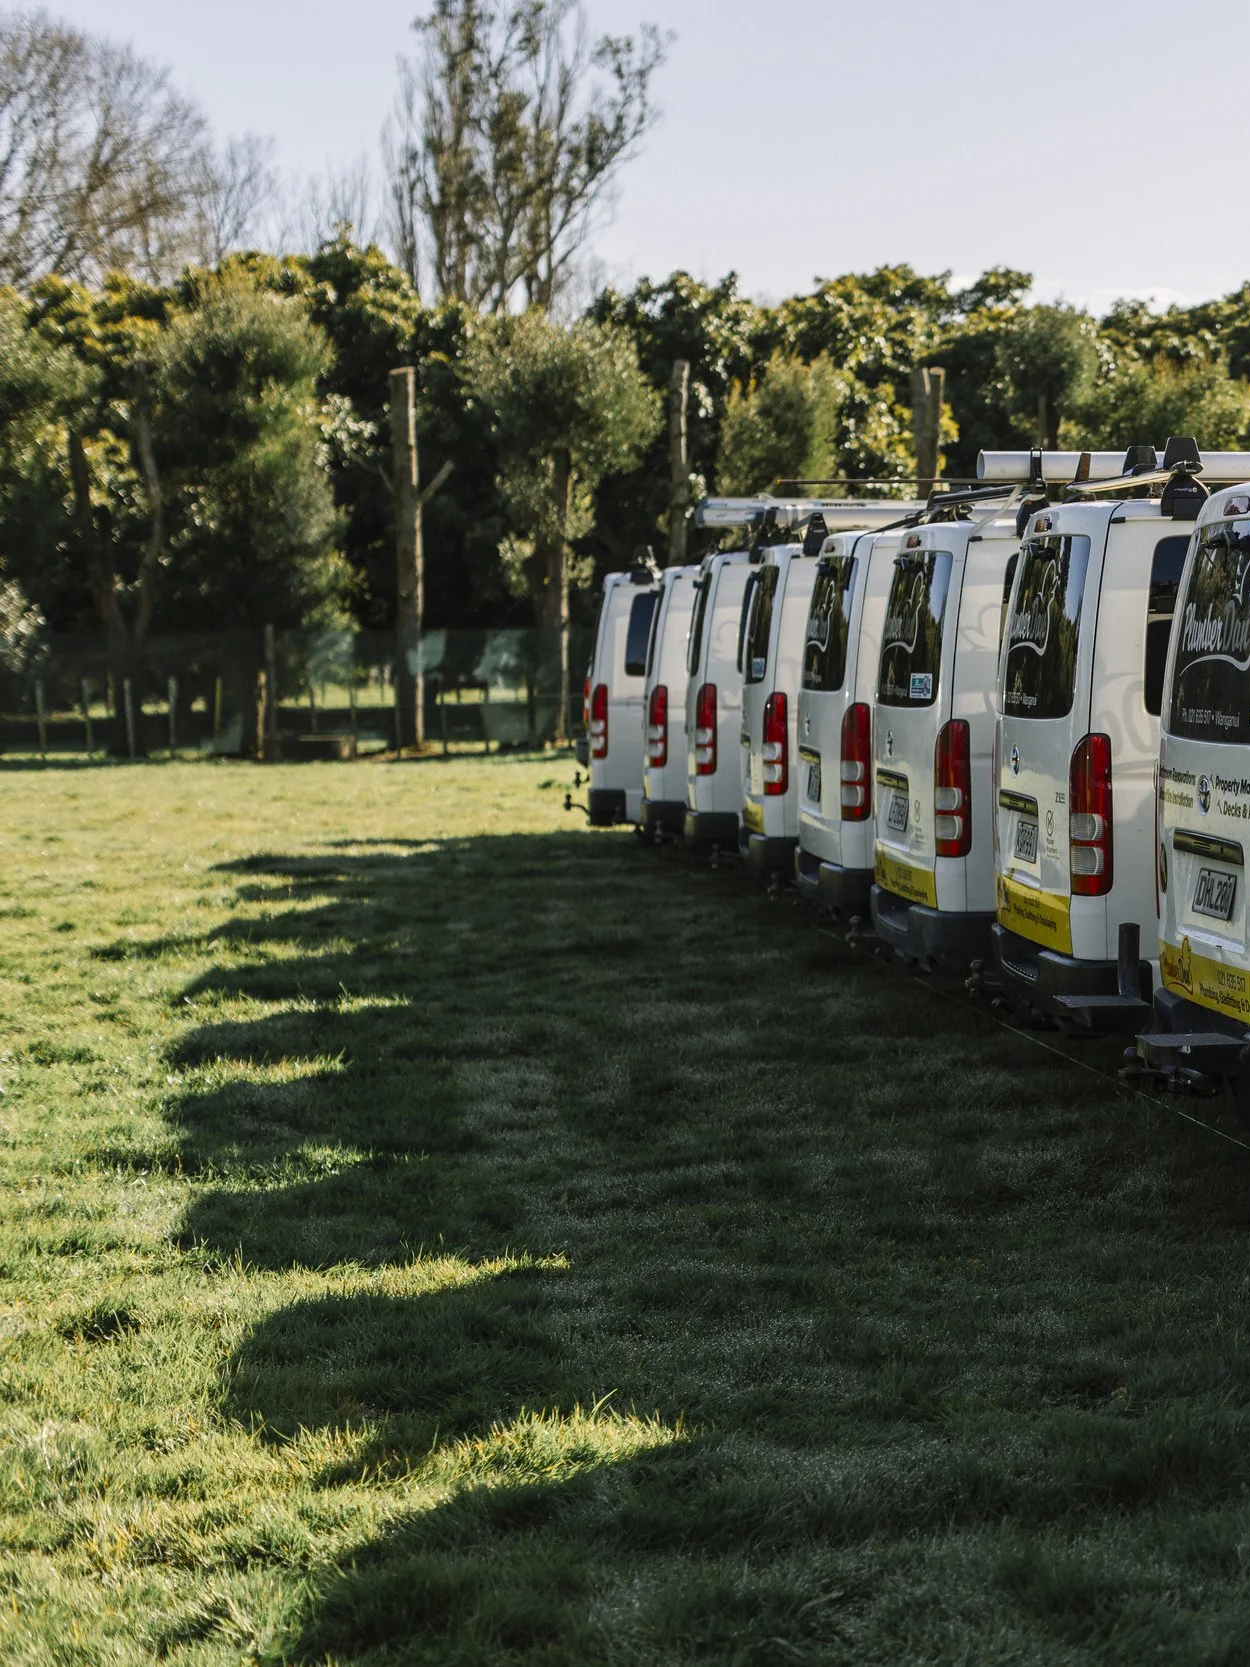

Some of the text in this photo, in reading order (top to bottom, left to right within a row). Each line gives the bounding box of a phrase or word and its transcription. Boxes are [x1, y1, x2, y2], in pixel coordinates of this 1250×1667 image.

[1215, 775, 1240, 797] Property
[1222, 800, 1242, 819] Decks
[1242, 803, 1247, 819] &
